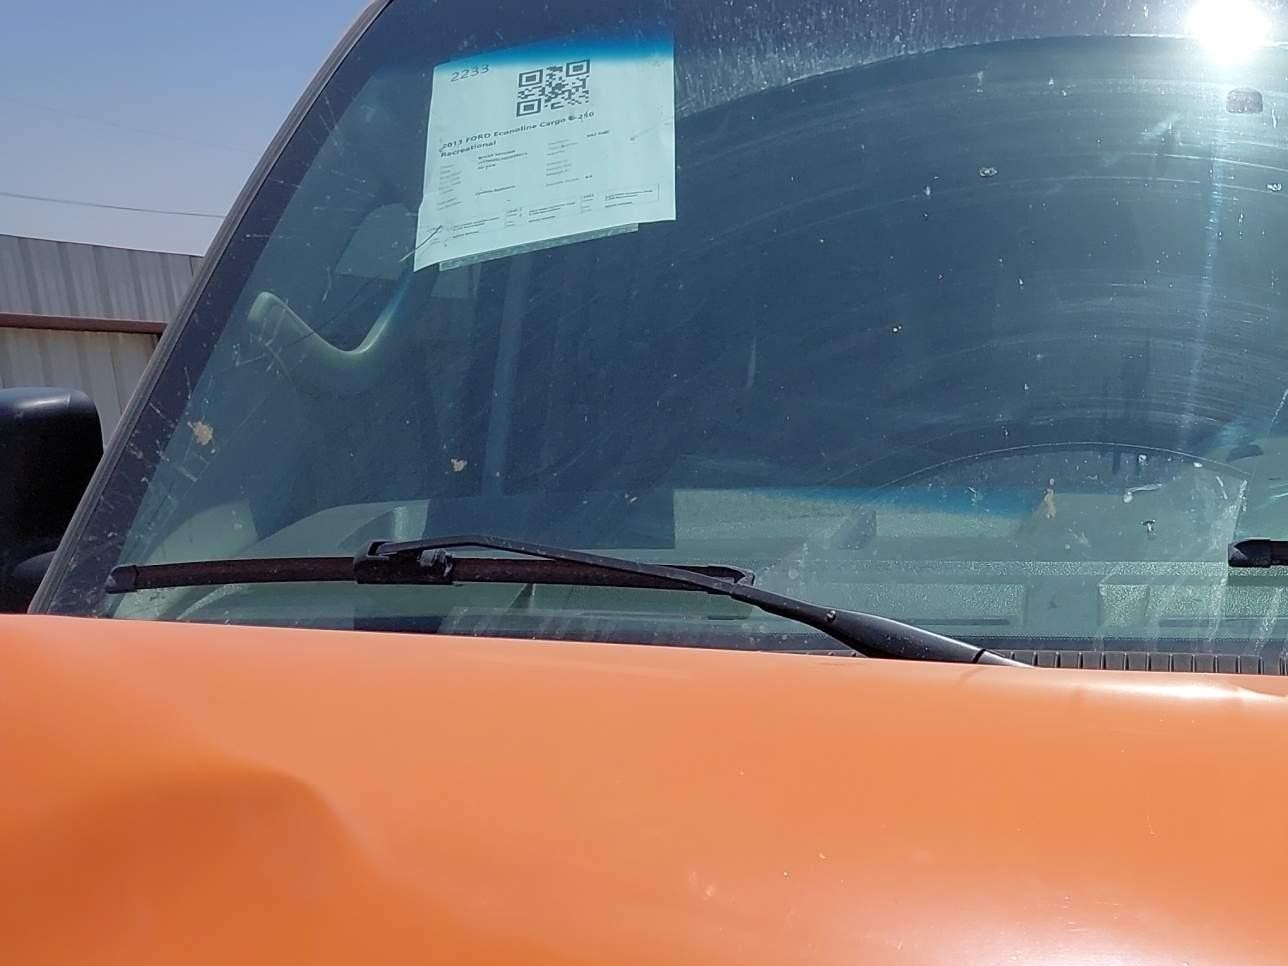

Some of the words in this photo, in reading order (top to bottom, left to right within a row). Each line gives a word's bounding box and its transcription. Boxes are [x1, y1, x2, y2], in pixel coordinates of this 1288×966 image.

[450, 63, 490, 83] 2233
[441, 138, 463, 150] 2013
[465, 132, 491, 143] FORD
[493, 121, 538, 137] Econoline
[539, 117, 566, 129] Cargo
[440, 140, 497, 158] Recreational
